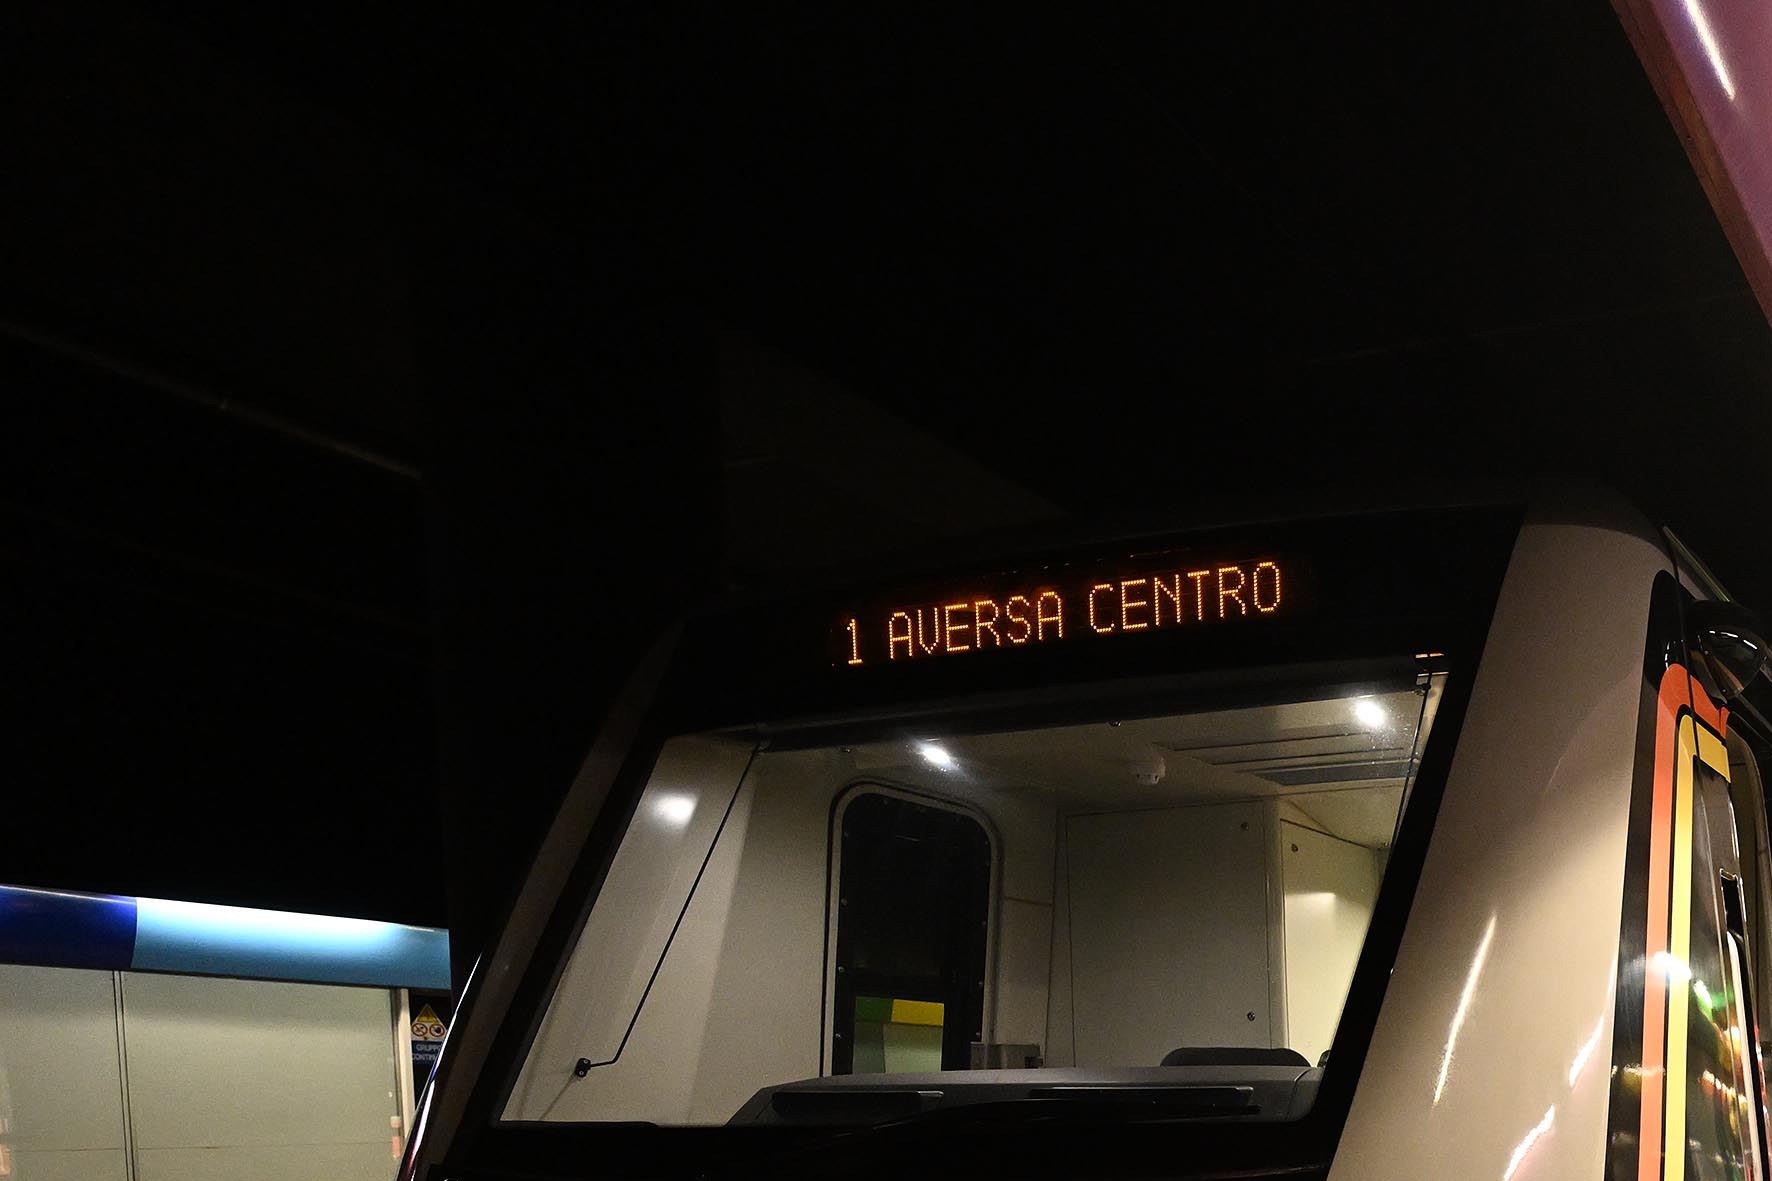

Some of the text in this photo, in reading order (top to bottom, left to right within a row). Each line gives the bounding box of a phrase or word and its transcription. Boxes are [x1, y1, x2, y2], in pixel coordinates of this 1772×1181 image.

[846, 561, 1281, 664] 1 AVERSA CENTRO
